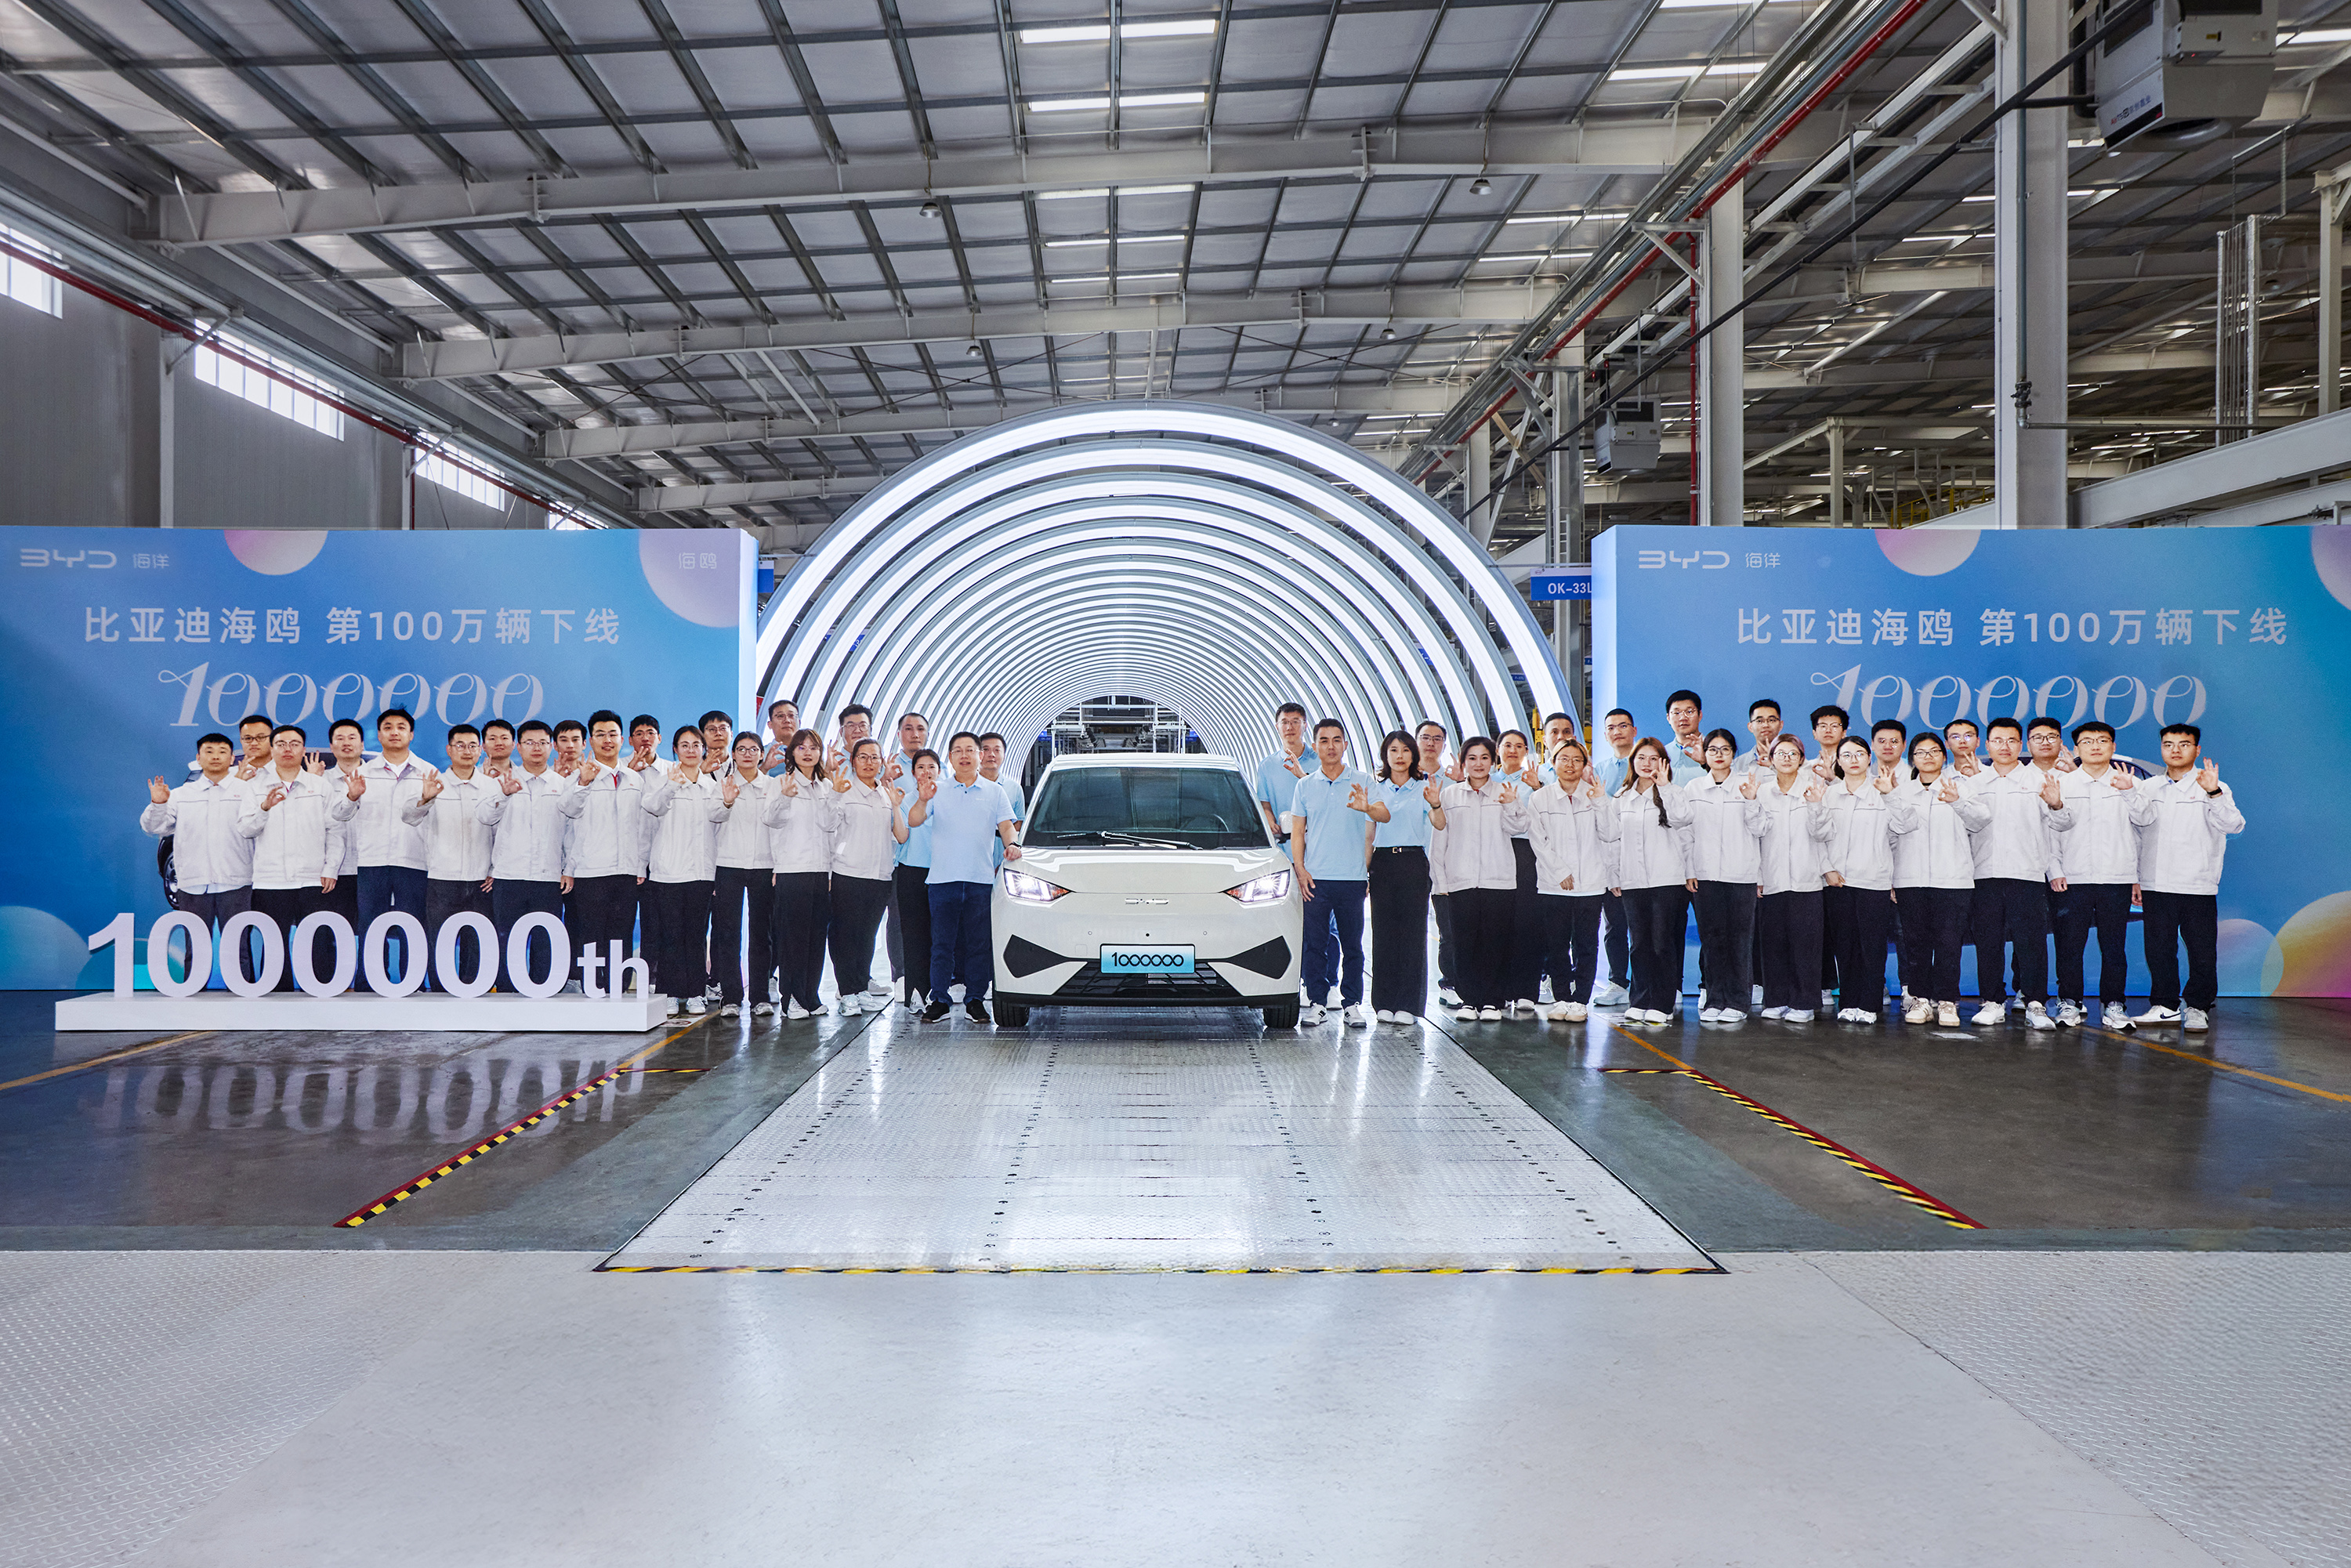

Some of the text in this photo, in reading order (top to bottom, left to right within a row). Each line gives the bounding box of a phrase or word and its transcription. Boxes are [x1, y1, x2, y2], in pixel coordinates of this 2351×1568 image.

[20, 548, 117, 569] BYD
[1638, 550, 1781, 569] BYD 海洋
[84, 606, 621, 645] 比亚迪海鸥 第100万辆下线
[1737, 607, 2288, 646] 比亚迪海鸥 第100万辆下线
[158, 661, 545, 727] 1000000
[1111, 951, 1184, 967] 1000000
